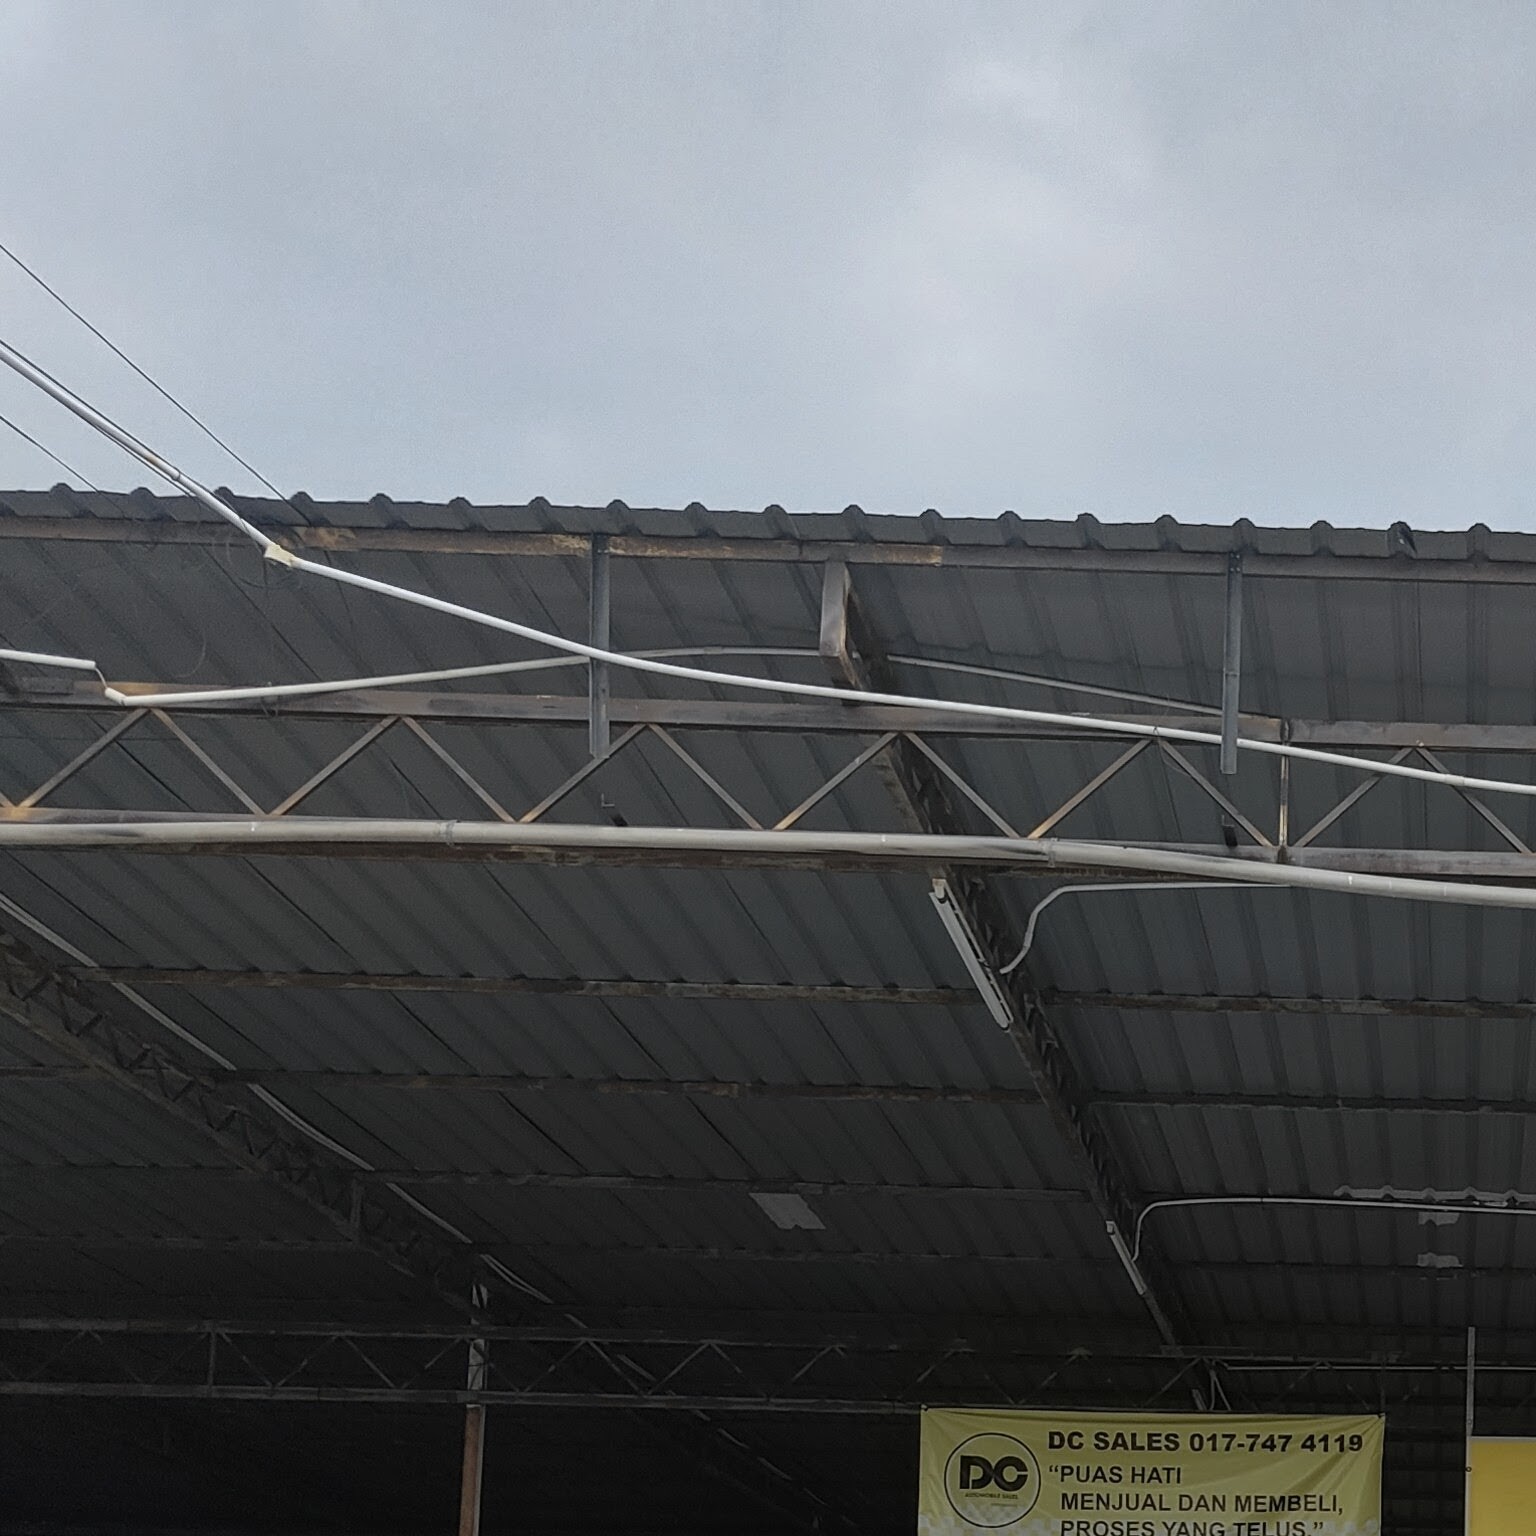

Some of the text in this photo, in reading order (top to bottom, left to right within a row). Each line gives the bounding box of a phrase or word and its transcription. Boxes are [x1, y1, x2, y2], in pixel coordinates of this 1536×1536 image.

[1048, 1431, 1363, 1453] DC SALES 017-747 4119
[959, 1455, 1028, 1492] DC
[1130, 1466, 1182, 1484] HATI
[1061, 1494, 1343, 1515] MENJUAL DAN MEMBELI,
